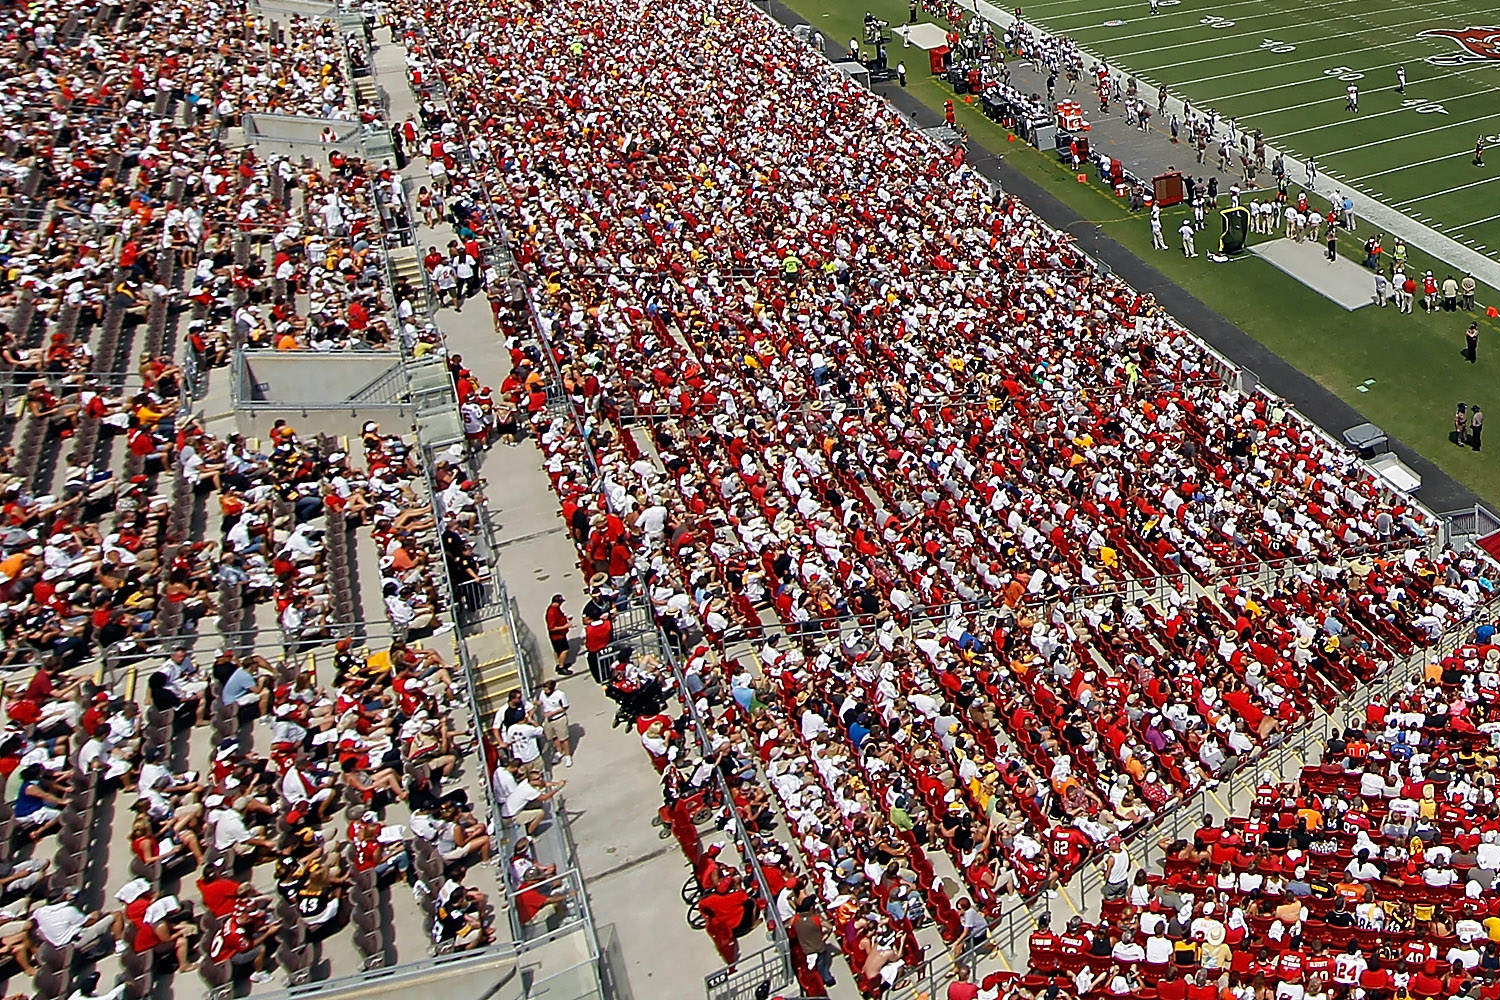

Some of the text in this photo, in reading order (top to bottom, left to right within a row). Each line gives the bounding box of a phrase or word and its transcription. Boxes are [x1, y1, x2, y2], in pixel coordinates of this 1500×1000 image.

[1106, 687, 1120, 698] 24
[1054, 840, 1068, 855] 82
[299, 898, 318, 913] 43
[1406, 952, 1424, 963] 40
[1338, 962, 1357, 980] 24
